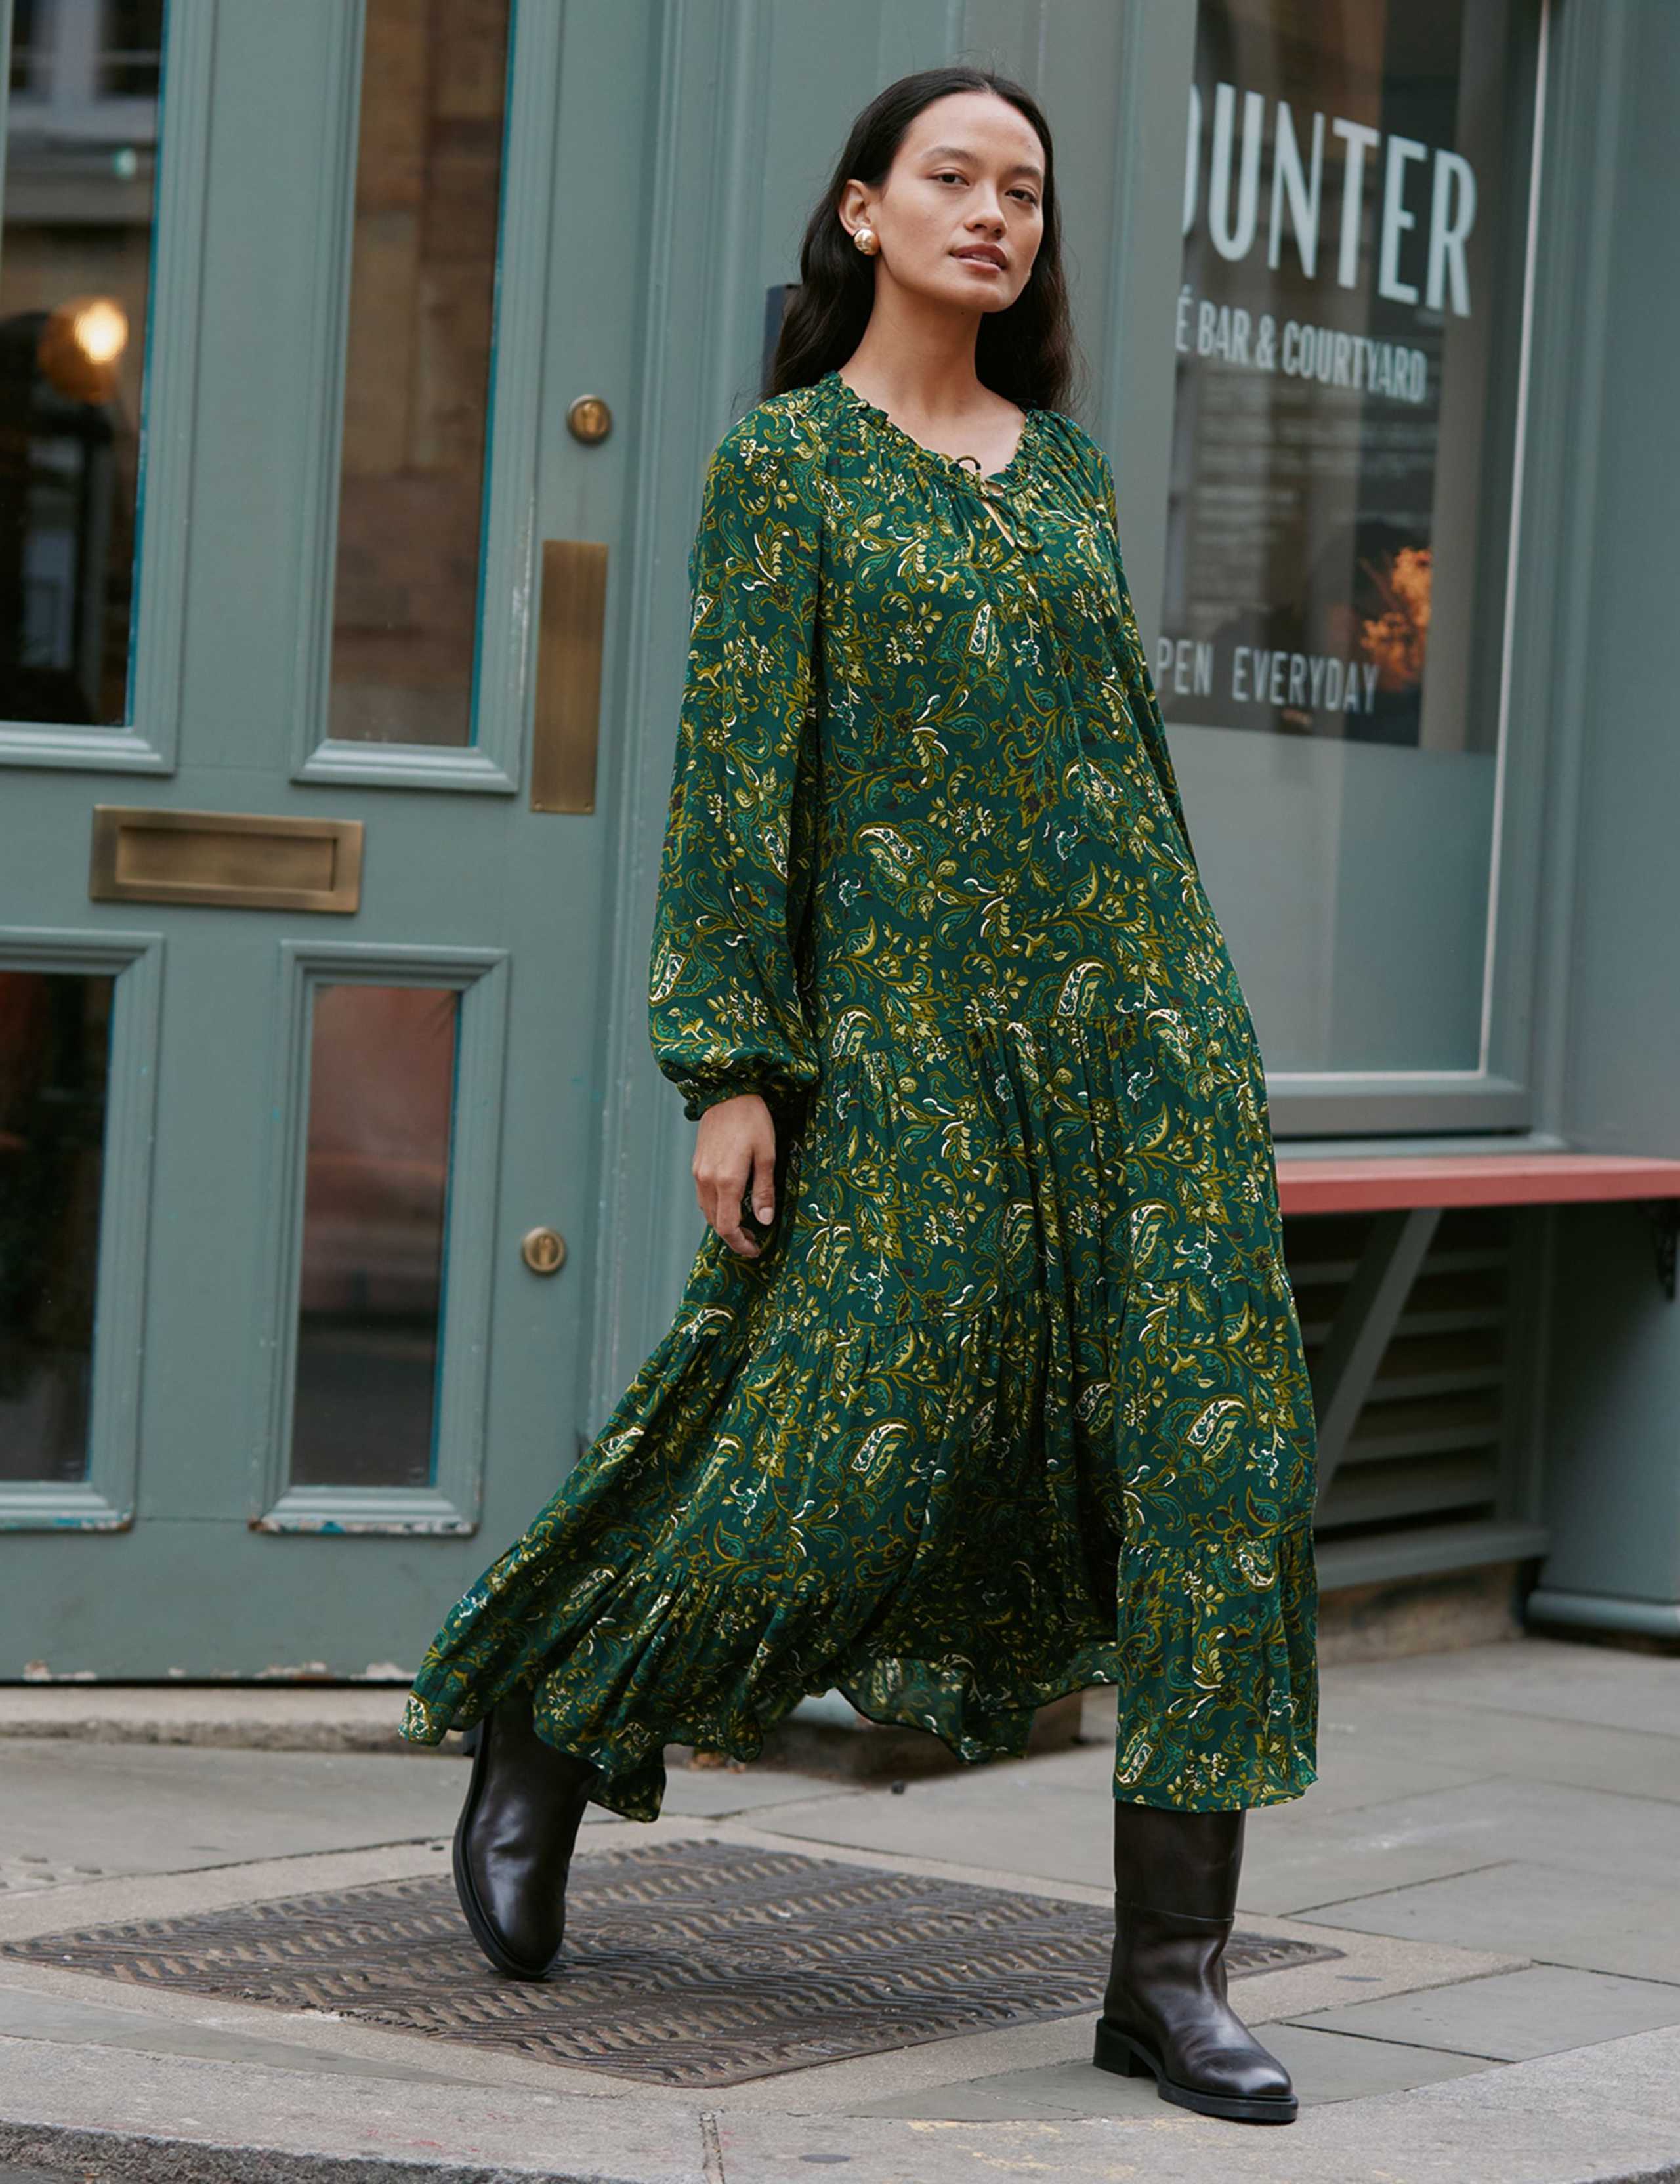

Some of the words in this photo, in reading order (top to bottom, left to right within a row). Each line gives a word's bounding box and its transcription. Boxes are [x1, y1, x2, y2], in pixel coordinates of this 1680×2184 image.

[1183, 81, 1477, 318] UNTER
[1197, 299, 1252, 366] BAR
[1255, 314, 1276, 370] &
[1282, 320, 1428, 404] COURTYARD
[1232, 646, 1379, 714] EVERYDAY
